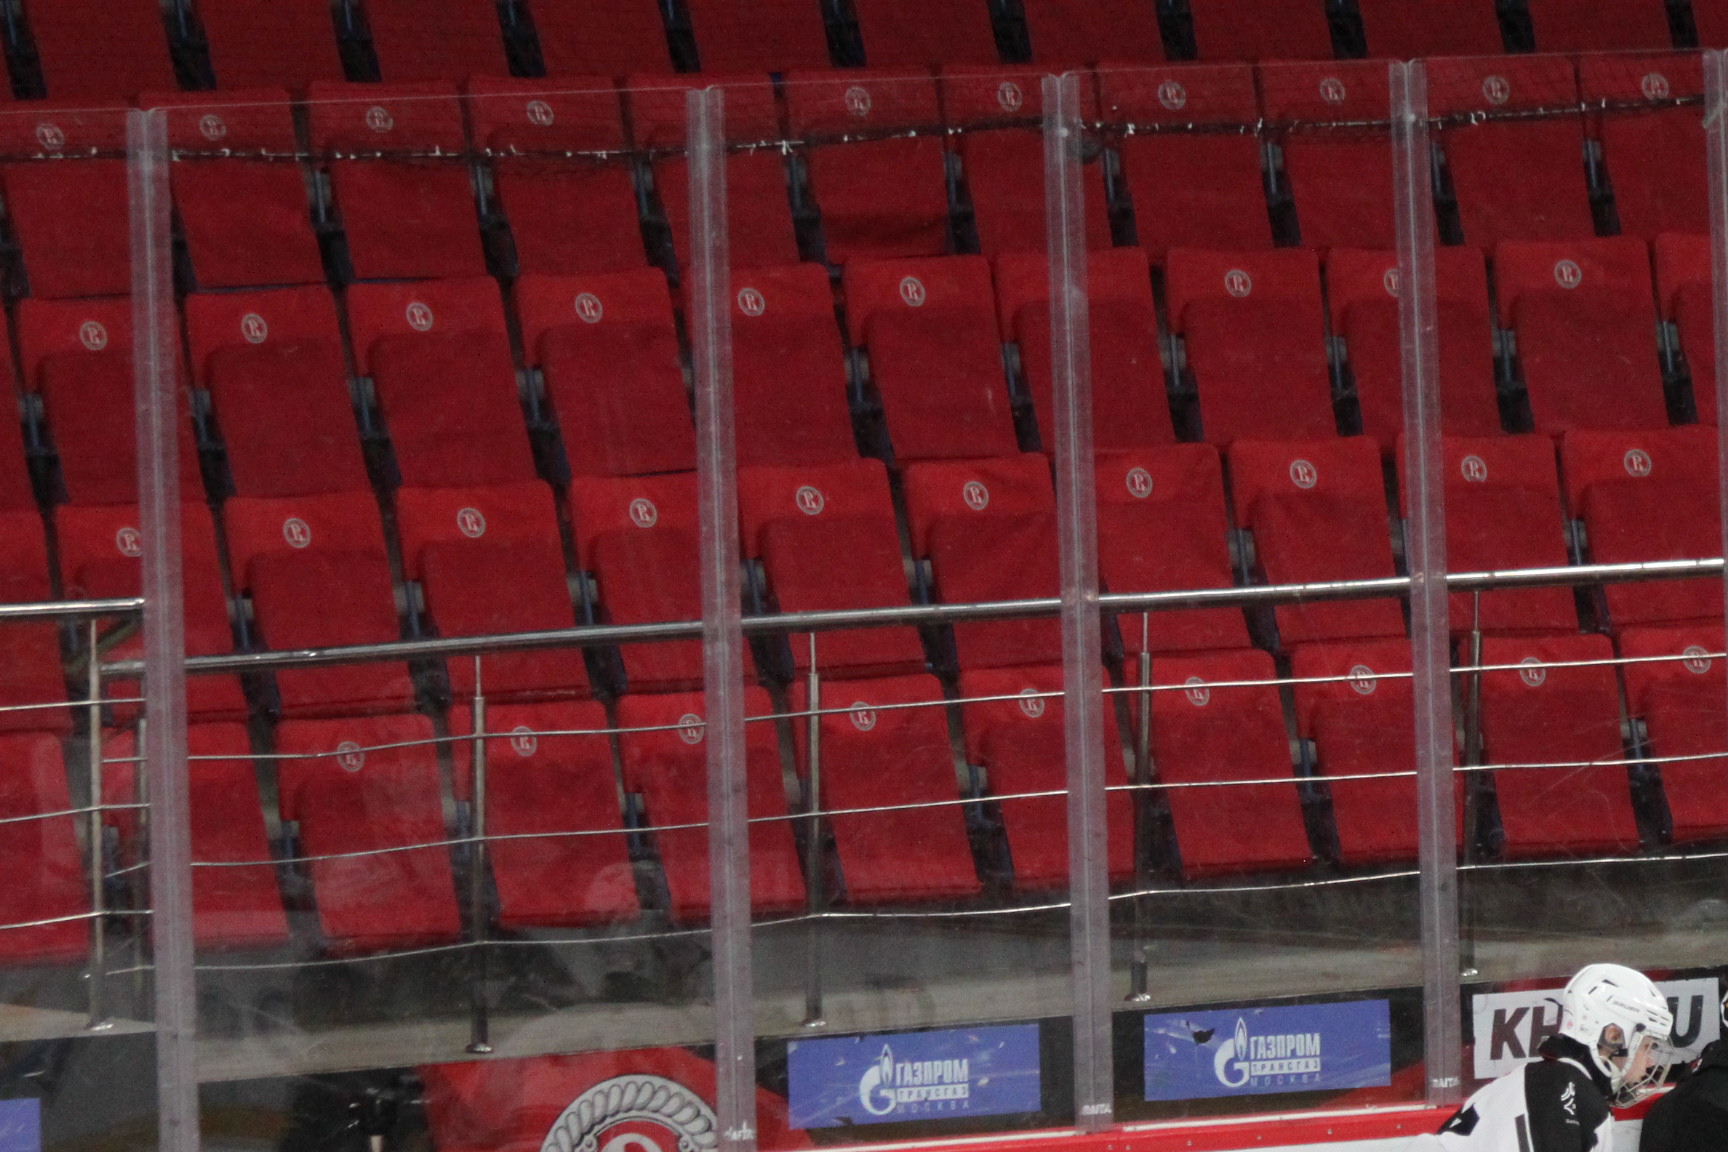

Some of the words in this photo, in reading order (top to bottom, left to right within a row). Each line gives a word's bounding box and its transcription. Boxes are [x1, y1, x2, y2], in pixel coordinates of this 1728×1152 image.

[1250, 1032, 1321, 1058] ГАЗПРОМ
[896, 1058, 970, 1086] ГАЗПРОМ
[1251, 1060, 1321, 1075] ТРАНСГАЗ
[1250, 1073, 1322, 1088] МОСКВА
[897, 1084, 970, 1103] ТРАНСГАЗ
